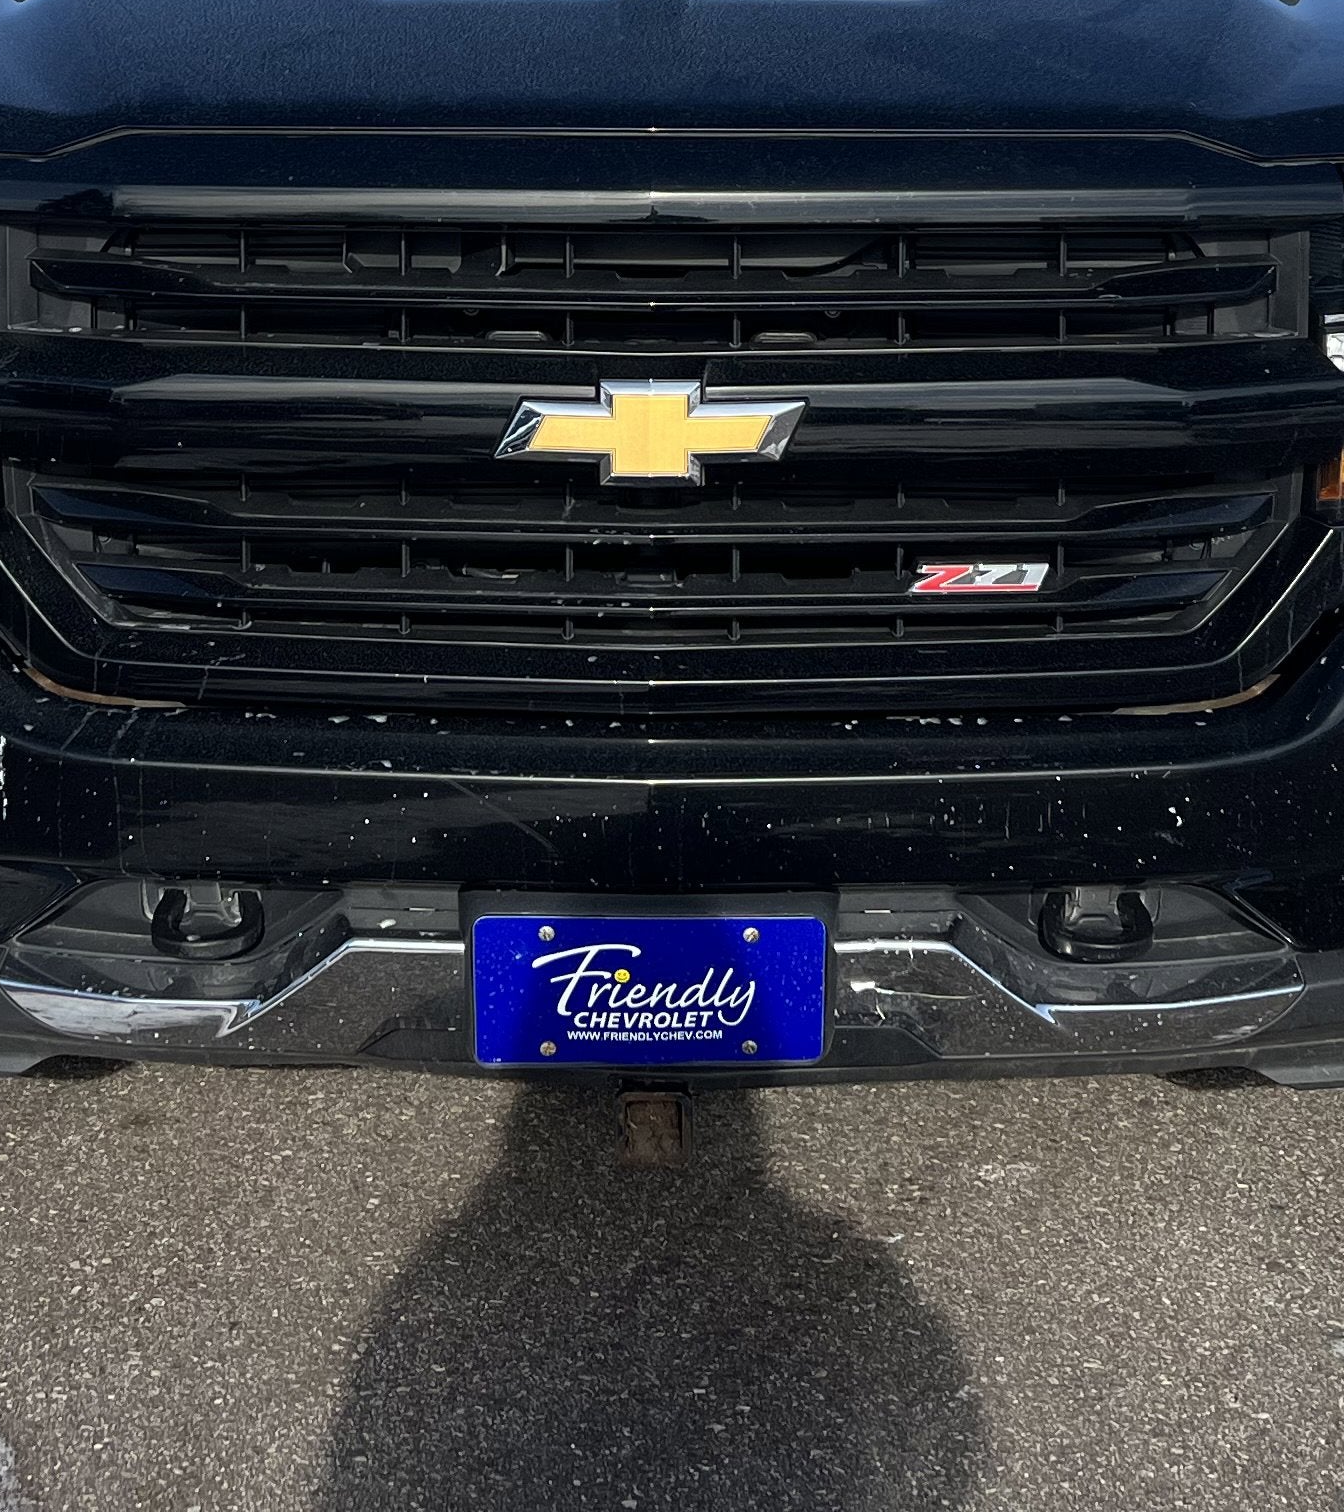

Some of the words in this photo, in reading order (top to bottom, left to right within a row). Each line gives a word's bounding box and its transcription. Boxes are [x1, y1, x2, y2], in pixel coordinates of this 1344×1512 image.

[911, 563, 1049, 592] Z71
[531, 943, 756, 1026] Friendly
[573, 1011, 714, 1029] CHEVROLET
[566, 1029, 723, 1042] WWW.FRIENDLYCHEV.COM
